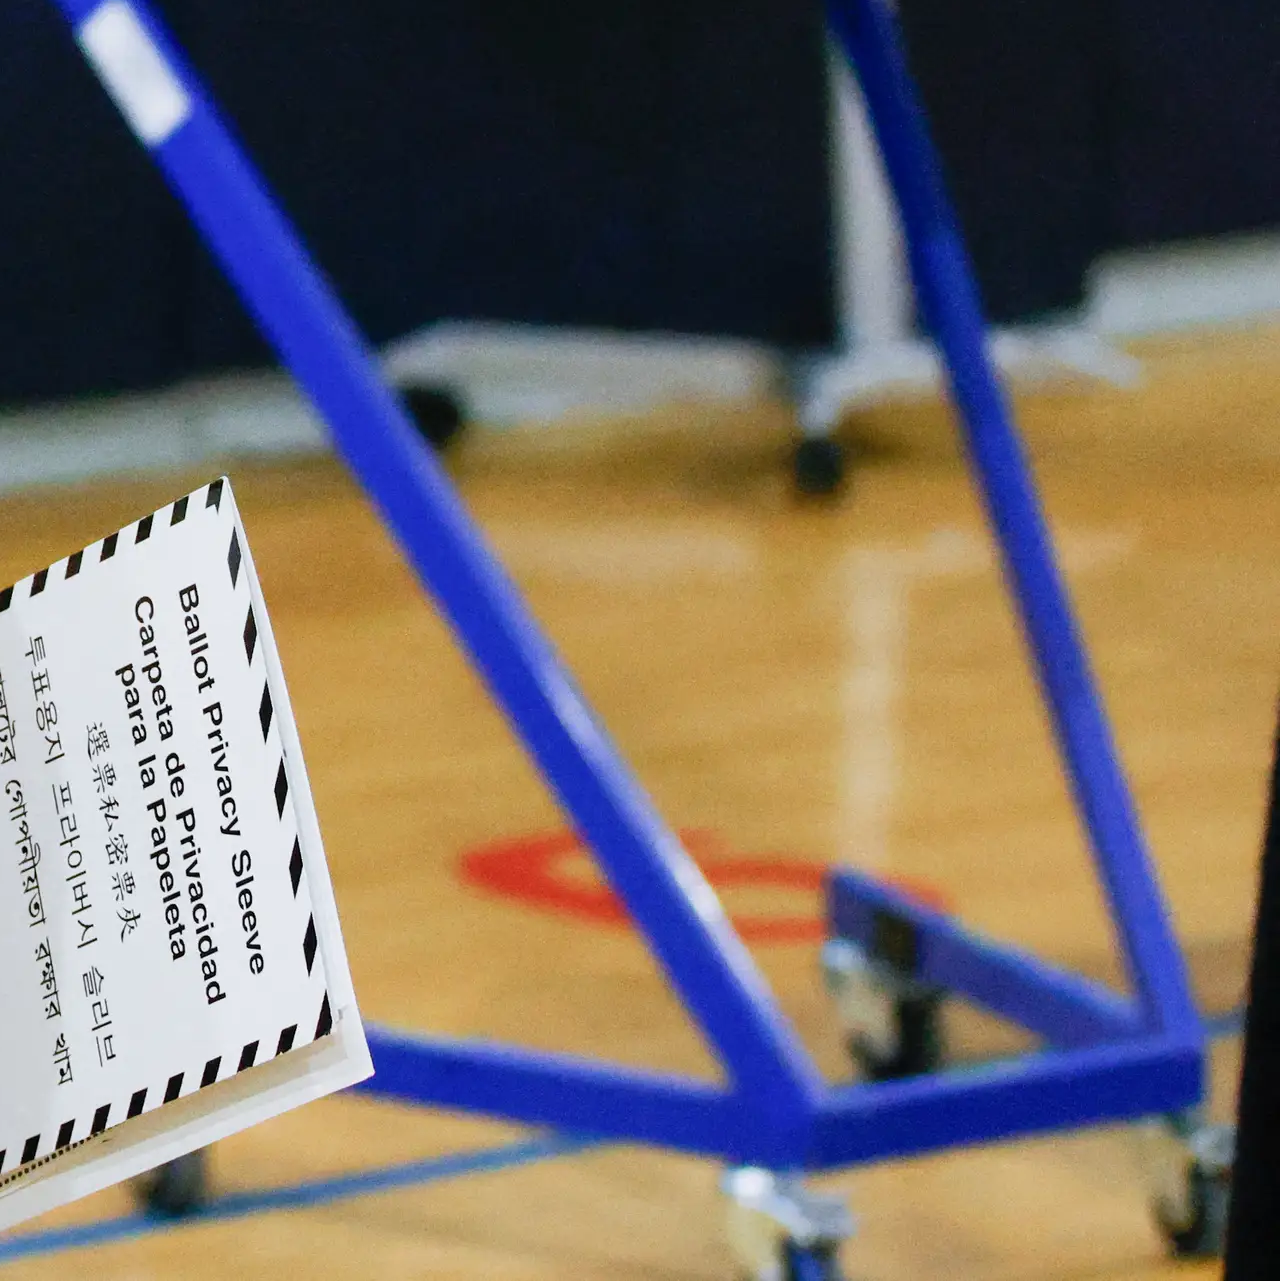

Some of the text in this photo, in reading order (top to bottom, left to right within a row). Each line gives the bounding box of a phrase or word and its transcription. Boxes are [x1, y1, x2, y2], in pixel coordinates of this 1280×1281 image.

[24, 635, 117, 1068] 투표용지 프라이버시 슬리브
[86, 722, 142, 943] 選票私密票夾
[114, 662, 186, 962] para la Papeleta
[134, 595, 227, 1006] Carpeta de Privacidad
[178, 583, 265, 975] Ballot Privacy Sleeve
